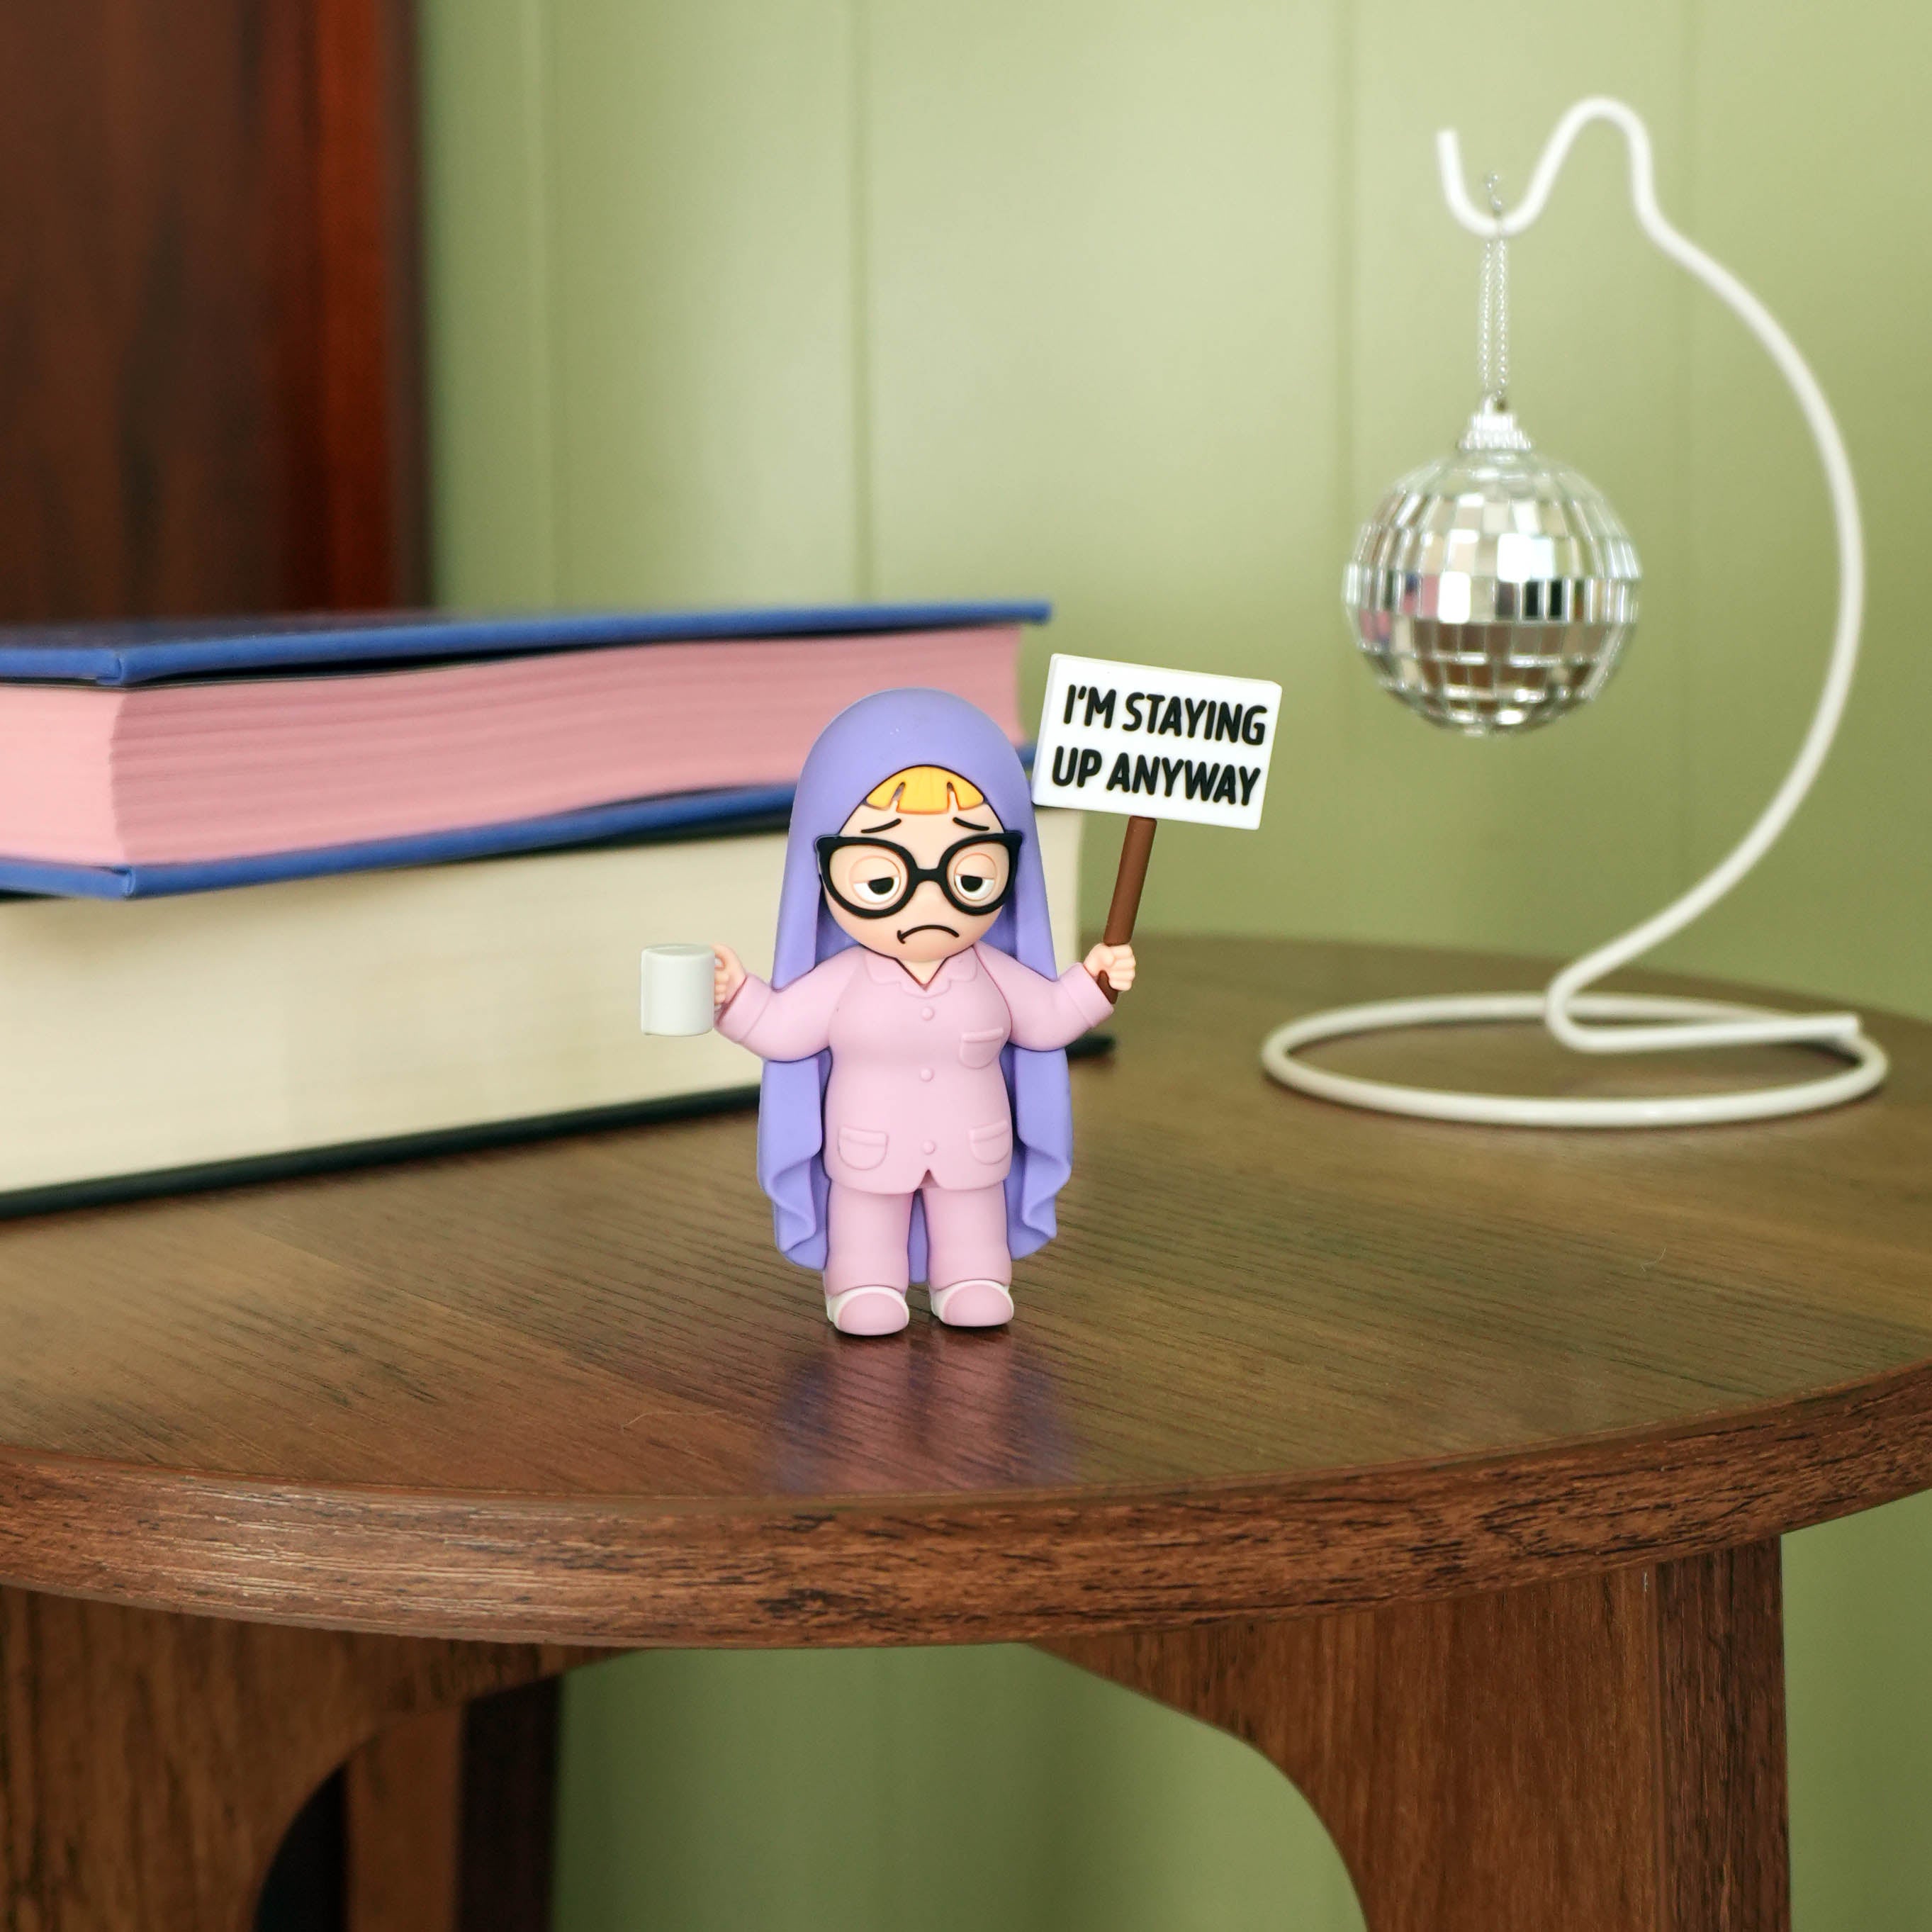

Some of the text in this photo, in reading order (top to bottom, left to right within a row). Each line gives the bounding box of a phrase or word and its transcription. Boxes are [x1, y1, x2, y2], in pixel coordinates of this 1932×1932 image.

[1063, 684, 1268, 746] I'M STAYING
[1052, 745, 1262, 807] UP ANYWAY
